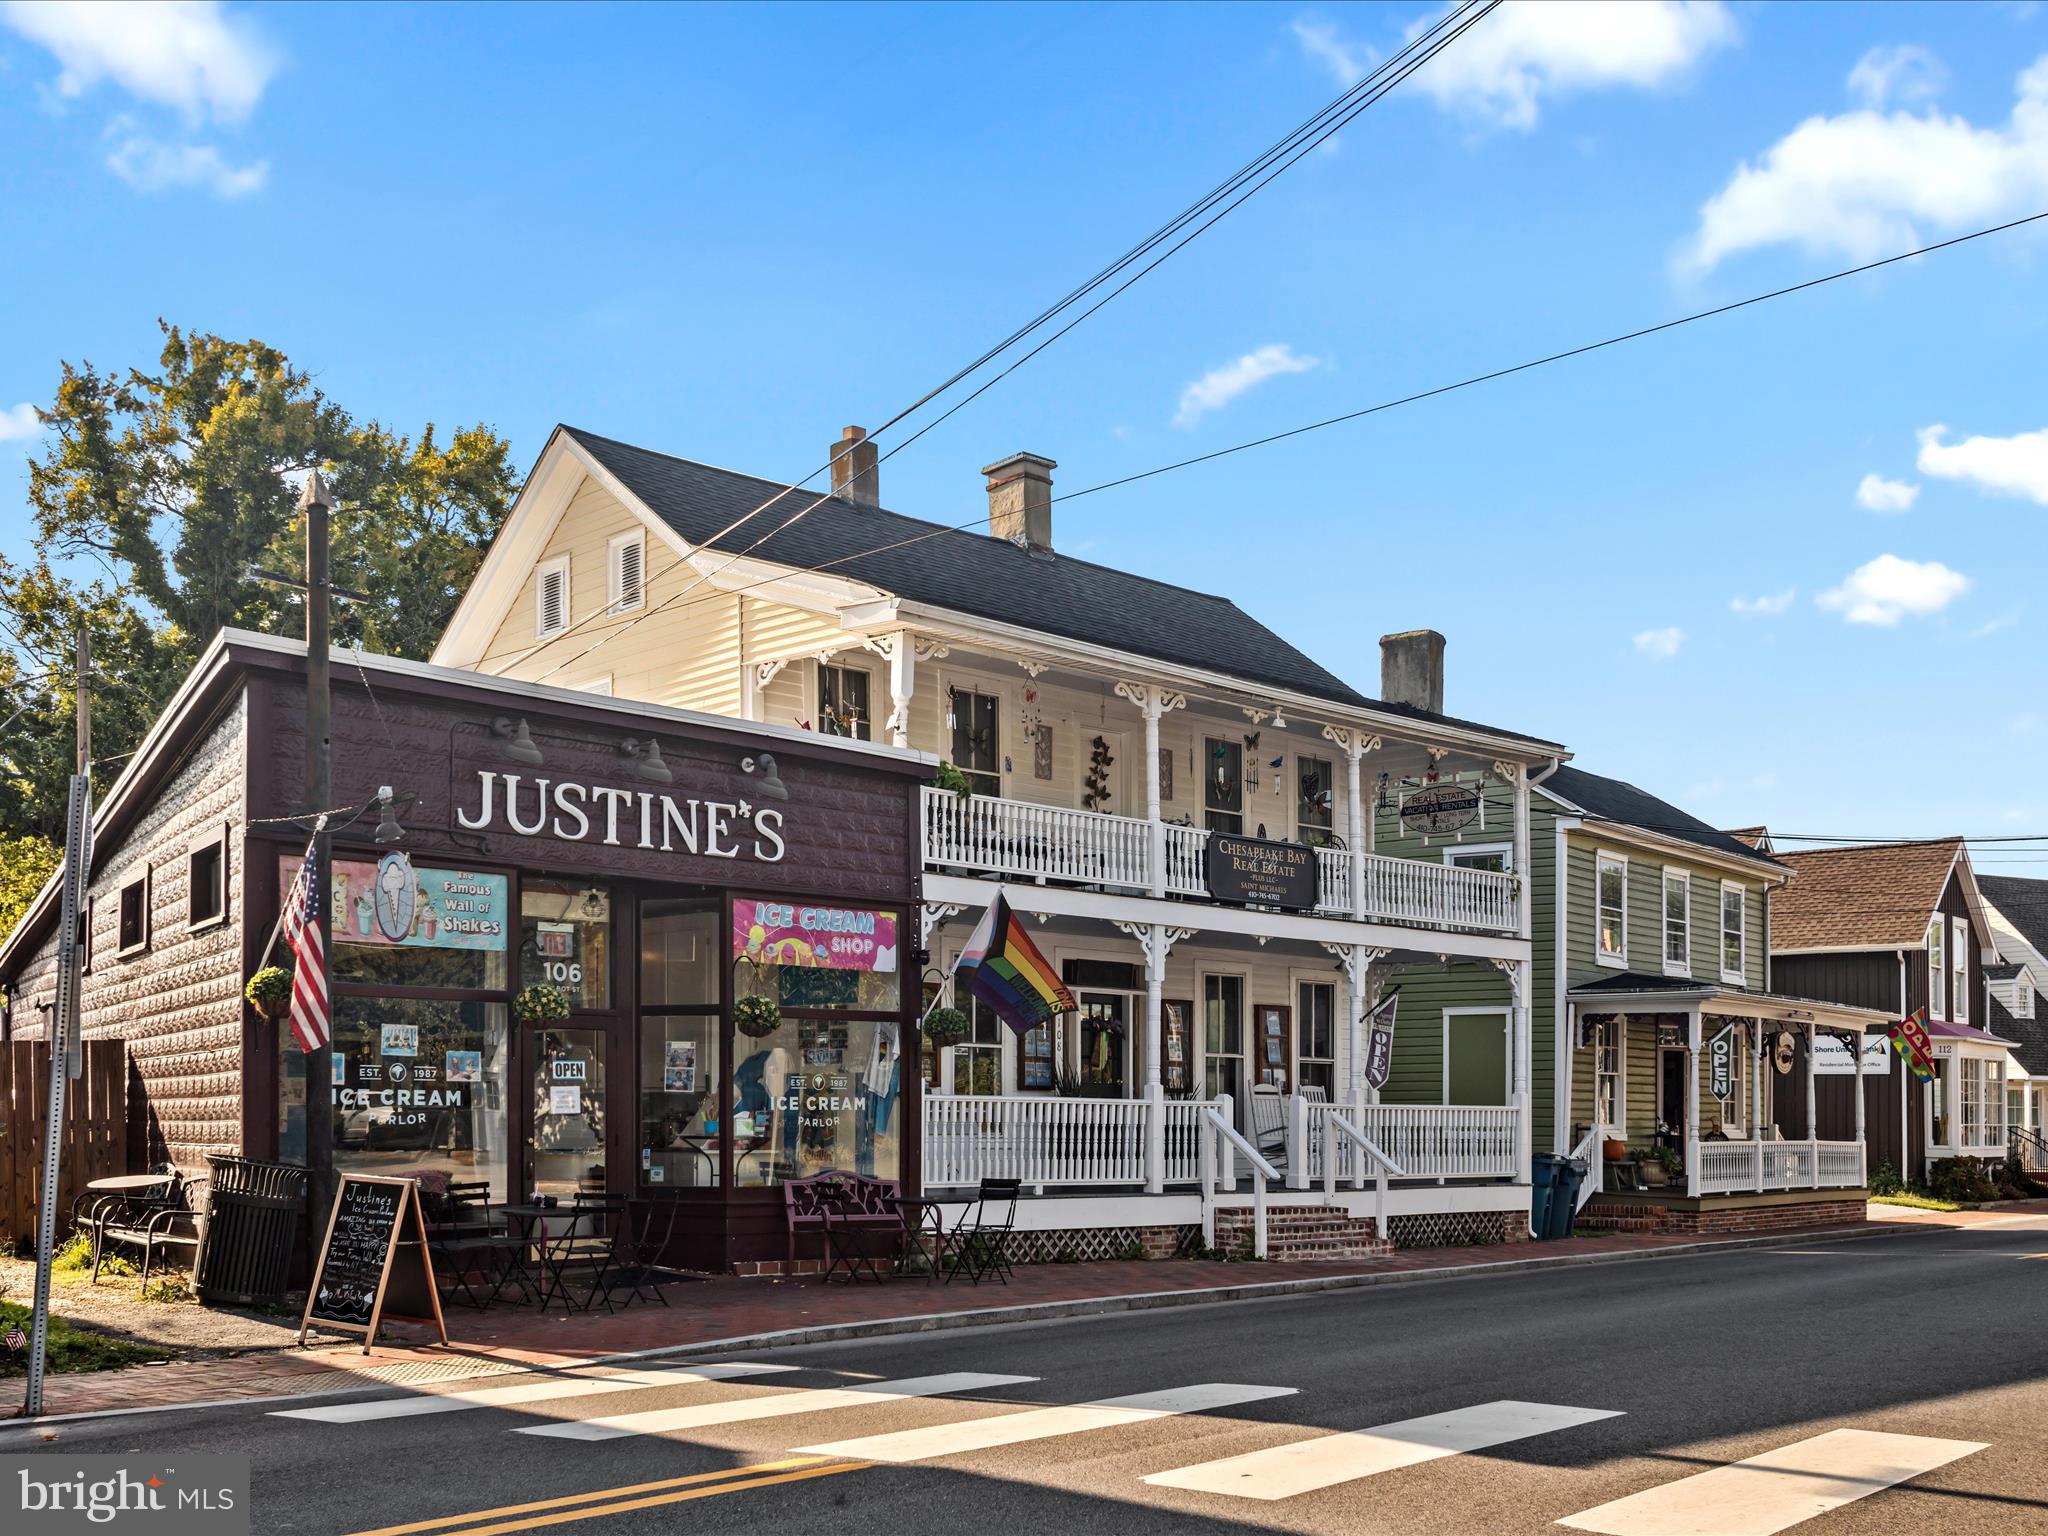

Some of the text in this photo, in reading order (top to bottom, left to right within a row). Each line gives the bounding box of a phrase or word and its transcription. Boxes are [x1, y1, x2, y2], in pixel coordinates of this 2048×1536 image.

[1412, 791, 1466, 804] REAL ESTATE
[1442, 800, 1476, 810] RENTALS
[457, 770, 785, 862] JUSTINE'S
[1219, 840, 1307, 865] CHESAPEAKE BAY
[1233, 857, 1296, 877] REAL ESTATE
[443, 881, 491, 897] Famous
[1240, 881, 1258, 891] SAINT
[445, 898, 491, 914] Wall of
[443, 916, 501, 936] Shakes
[755, 902, 875, 935] ICE CREAM
[831, 936, 874, 954] SHOP
[543, 962, 582, 983] 106
[1049, 1001, 1064, 1013] IS
[1814, 1045, 1835, 1053] Shore
[1903, 1021, 1934, 1067] OPE
[1938, 1045, 1952, 1054] 112
[1369, 1032, 1388, 1082] OPEN
[359, 1068, 437, 1078] EST. 1987
[555, 1062, 583, 1077] OPEN
[1713, 1040, 1729, 1094] OPEN
[790, 1079, 807, 1087] EST.
[332, 1089, 462, 1106] ICE CREAM
[770, 1097, 866, 1110] ICE CREAM
[369, 1113, 427, 1125] PARLOR
[798, 1116, 840, 1127] PARLOR
[346, 1183, 392, 1205] Justine's
[338, 1215, 366, 1224] AMAZING
